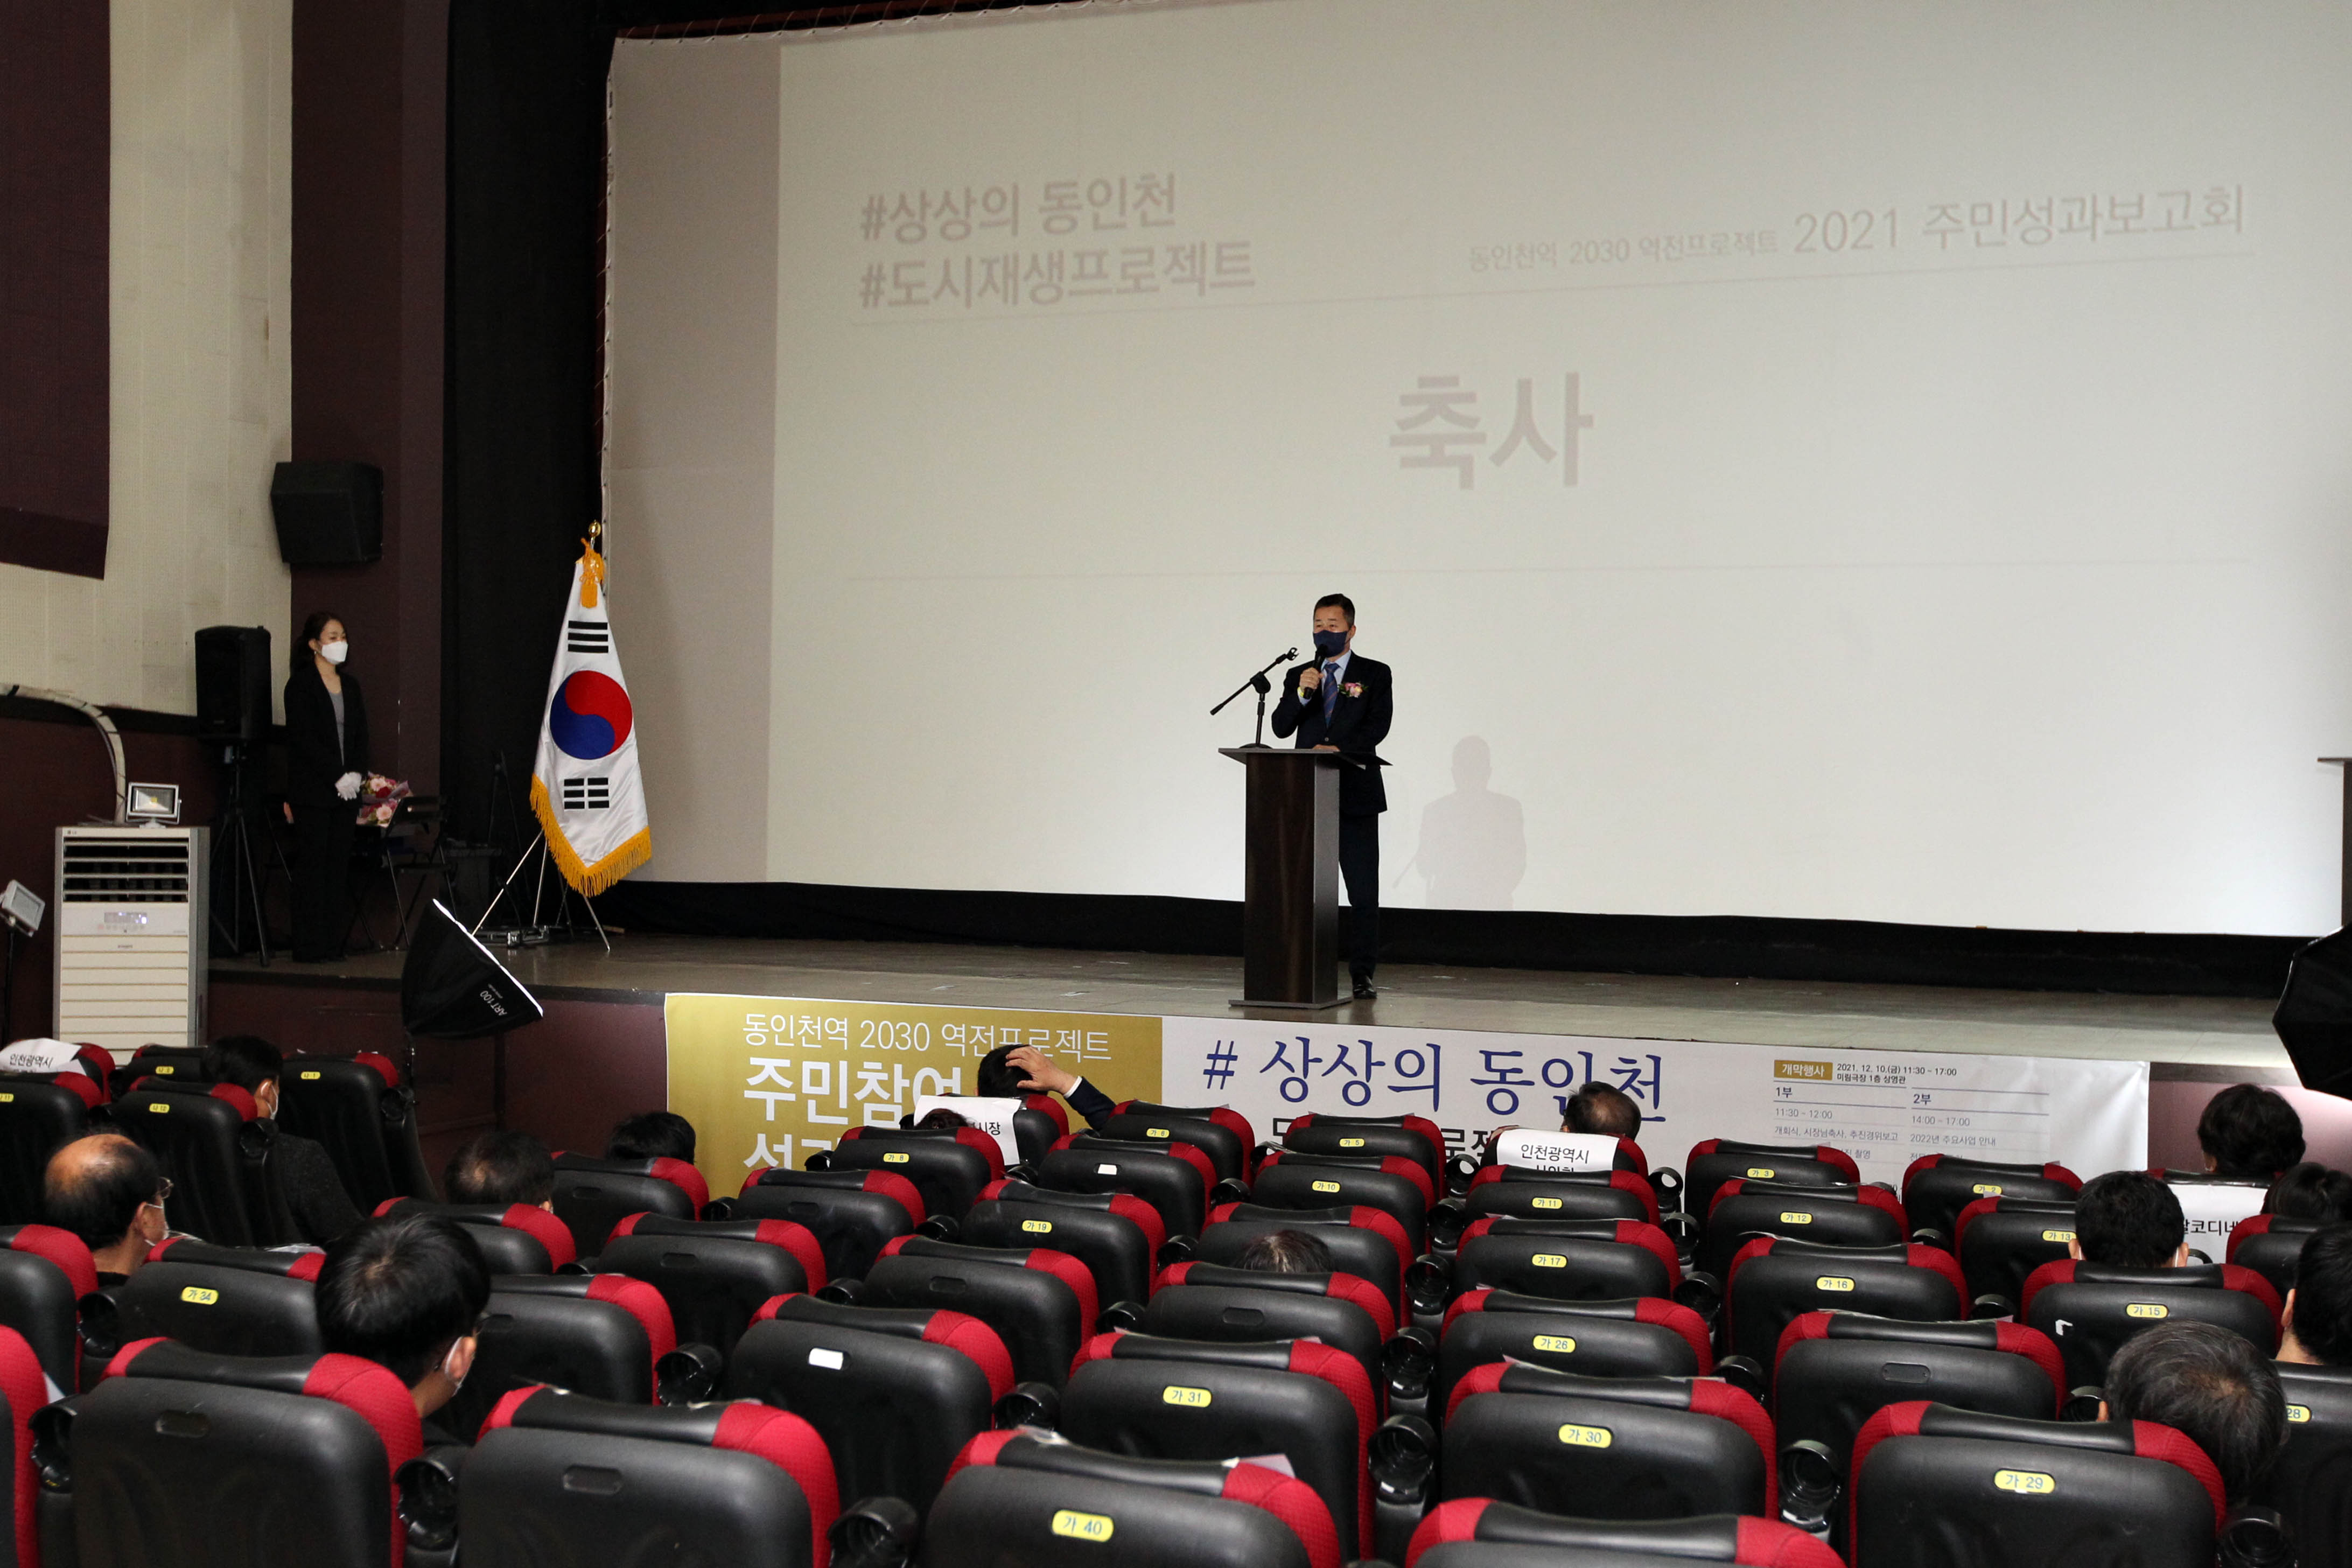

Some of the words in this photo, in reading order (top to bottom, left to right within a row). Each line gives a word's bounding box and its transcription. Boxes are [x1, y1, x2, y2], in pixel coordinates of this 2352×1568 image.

[860, 183, 1018, 244] #상상의
[1038, 172, 1175, 234] 동인천
[1468, 242, 1557, 273] 동인천역
[1569, 237, 1631, 265] 2030
[1639, 229, 1779, 263] 역전프로젝트
[1794, 208, 1899, 254] 2021
[1922, 184, 2243, 250] 주민성과보고회
[860, 241, 1255, 309] #도시재생프로젝트
[1389, 372, 1594, 490] 축사
[743, 1013, 849, 1050] 동인천역
[860, 1020, 930, 1052] 2030
[941, 1023, 1111, 1063] 역전프로젝트
[10, 1053, 53, 1069] 인천광역시
[1782, 1063, 1825, 1077] 개막행사
[1904, 1067, 1926, 1075] 11:30
[1935, 1068, 1957, 1076] 17:00
[1259, 1037, 1441, 1112] 상상의
[1470, 1050, 1666, 1122] 동인천
[1776, 1087, 1793, 1098] 1부
[1913, 1094, 1931, 1105] 2부
[1776, 1108, 1799, 1117] 11:30
[1809, 1110, 1833, 1119] 12:00
[1912, 1115, 1935, 1124] 14:00
[1946, 1117, 1970, 1126] 17:00
[1521, 1144, 1589, 1164] 인천광역시
[1538, 1199, 1545, 1207] 가
[1786, 1214, 1794, 1222] 가
[1027, 1222, 1035, 1230] 가
[1038, 1223, 1047, 1231] 19
[2049, 1232, 2056, 1240] 가
[2061, 1233, 2071, 1241] 13
[1538, 1256, 1546, 1265] 가
[1551, 1257, 1561, 1265] 17
[1824, 1279, 1832, 1288] 가
[1837, 1280, 1848, 1289] 16
[2134, 1306, 2143, 1315] 가
[2149, 1307, 2160, 1316] 15
[1541, 1338, 1551, 1349] 가
[1555, 1340, 1568, 1350] 26
[1172, 1390, 1183, 1402] 가
[1188, 1392, 1201, 1403] 31
[1569, 1429, 1580, 1442] 가
[1586, 1431, 1602, 1444] 30
[2006, 1474, 2019, 1488] 가
[2026, 1476, 2043, 1489] 29
[1065, 1516, 1076, 1532] 가
[1083, 1520, 1102, 1534] 40
